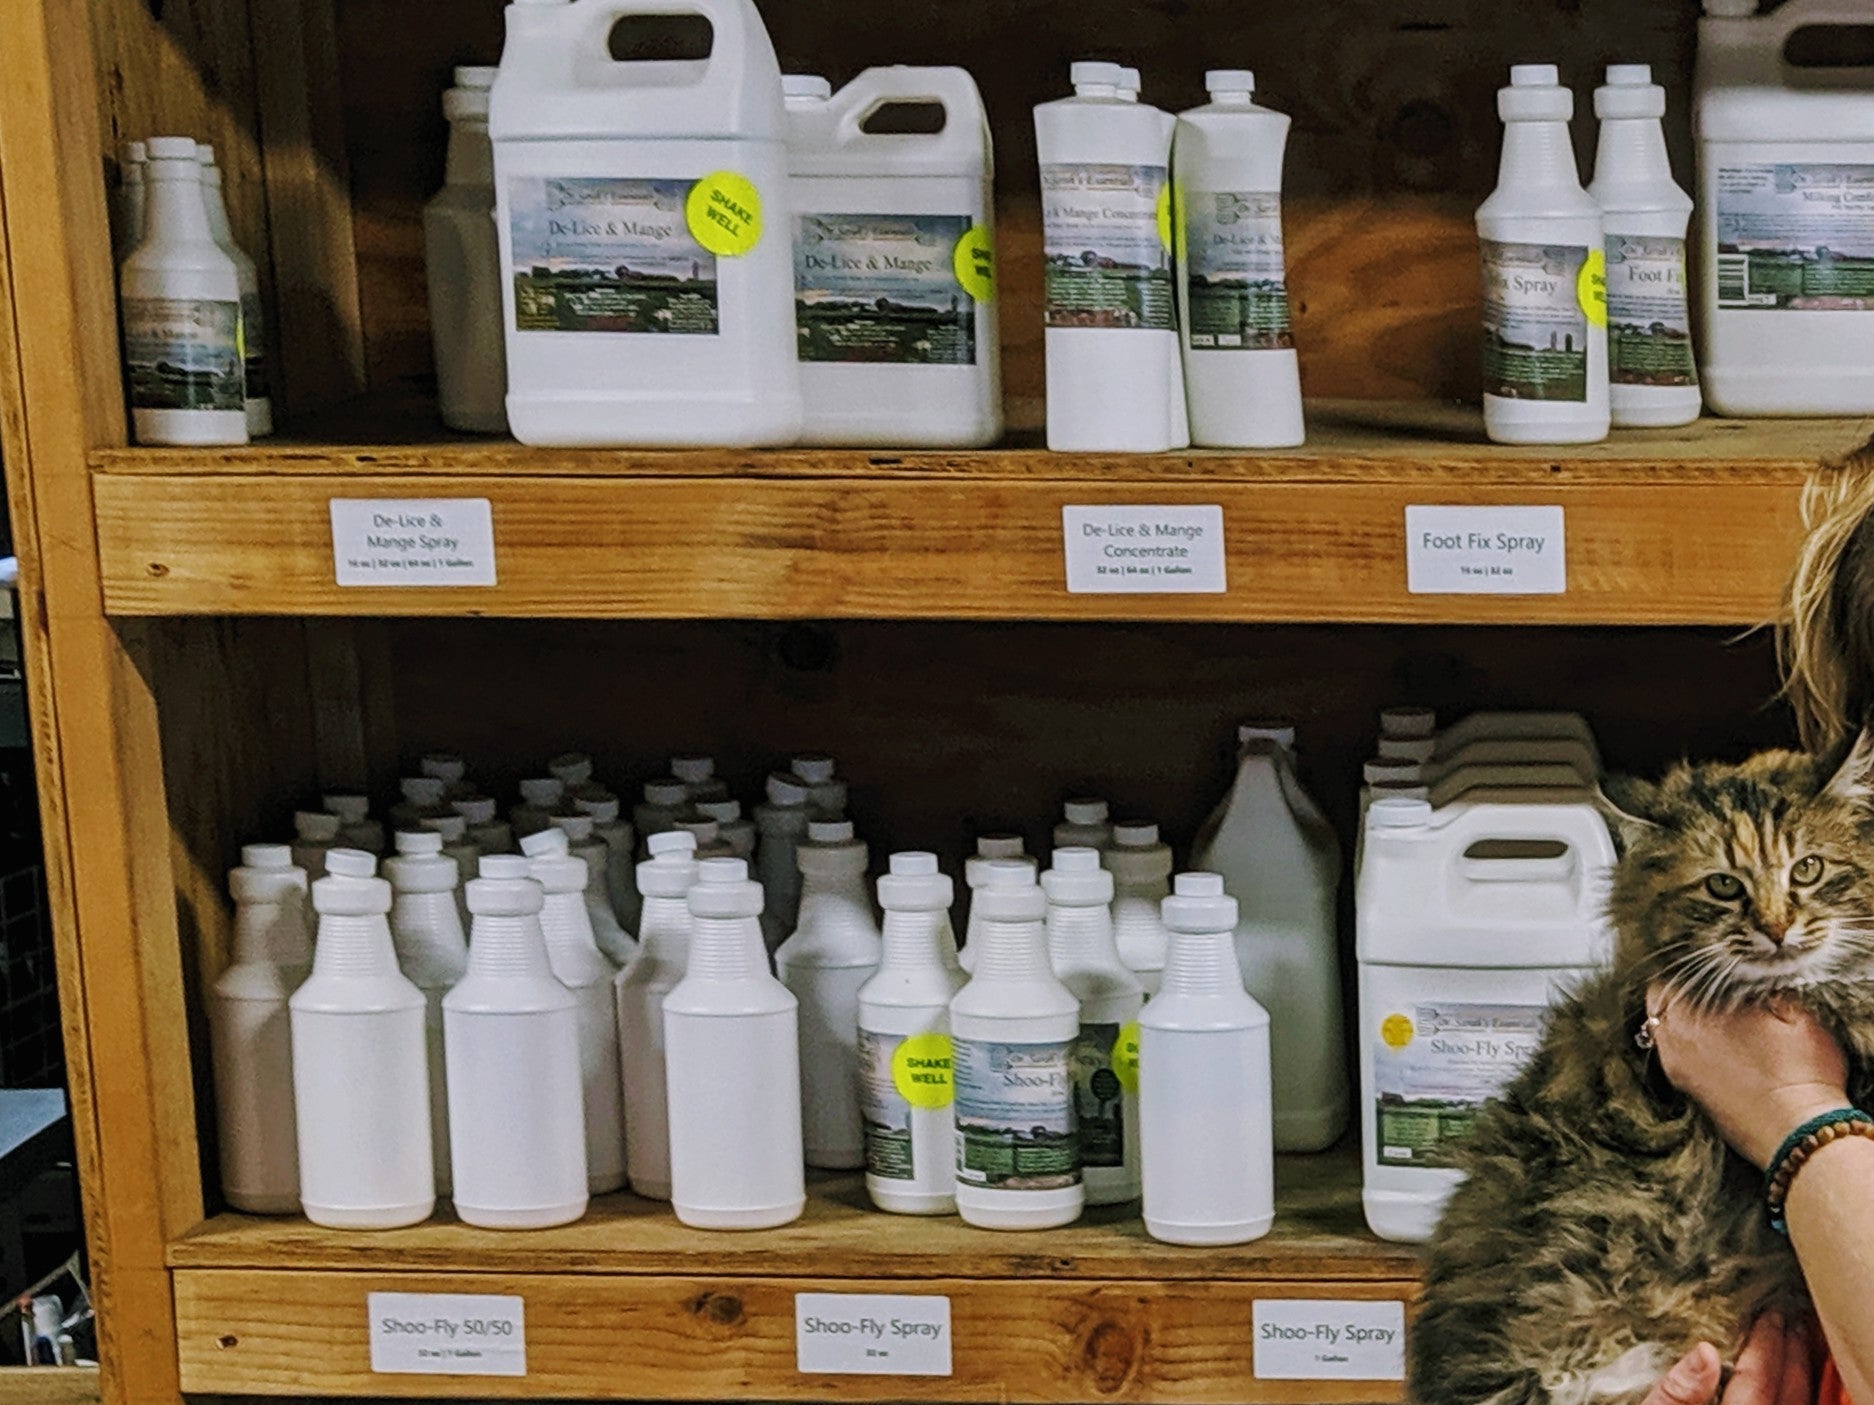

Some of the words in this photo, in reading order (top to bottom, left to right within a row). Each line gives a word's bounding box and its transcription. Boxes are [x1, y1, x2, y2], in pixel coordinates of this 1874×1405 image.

[710, 188, 754, 226] SHAKE
[706, 204, 741, 238] WELL
[1628, 264, 1664, 282] Foot
[1514, 276, 1557, 296] Spray
[373, 513, 427, 528] De-Lice
[430, 513, 444, 528] &
[1082, 523, 1135, 537] De-Lice
[1139, 523, 1150, 537] &
[1155, 524, 1203, 541] Mange
[366, 535, 416, 551] Mange
[419, 534, 459, 552] Spray
[1104, 544, 1189, 558] Concentrate
[1423, 532, 1463, 550] Foot
[1468, 532, 1491, 550] Fix
[1496, 533, 1546, 555] Spray
[1430, 1039, 1500, 1059] Shoo-Fly
[907, 1058, 951, 1070] SHAKE
[912, 1073, 948, 1085] WELL
[1003, 1073, 1061, 1089] Shoo-F
[382, 1317, 458, 1341] Shoo-Fly
[463, 1318, 513, 1338] 50/50
[804, 1316, 885, 1339] Shoo-Fly
[890, 1318, 942, 1341] Spray
[1261, 1323, 1340, 1344] Shoo-Fly
[1345, 1325, 1396, 1345] Spray
